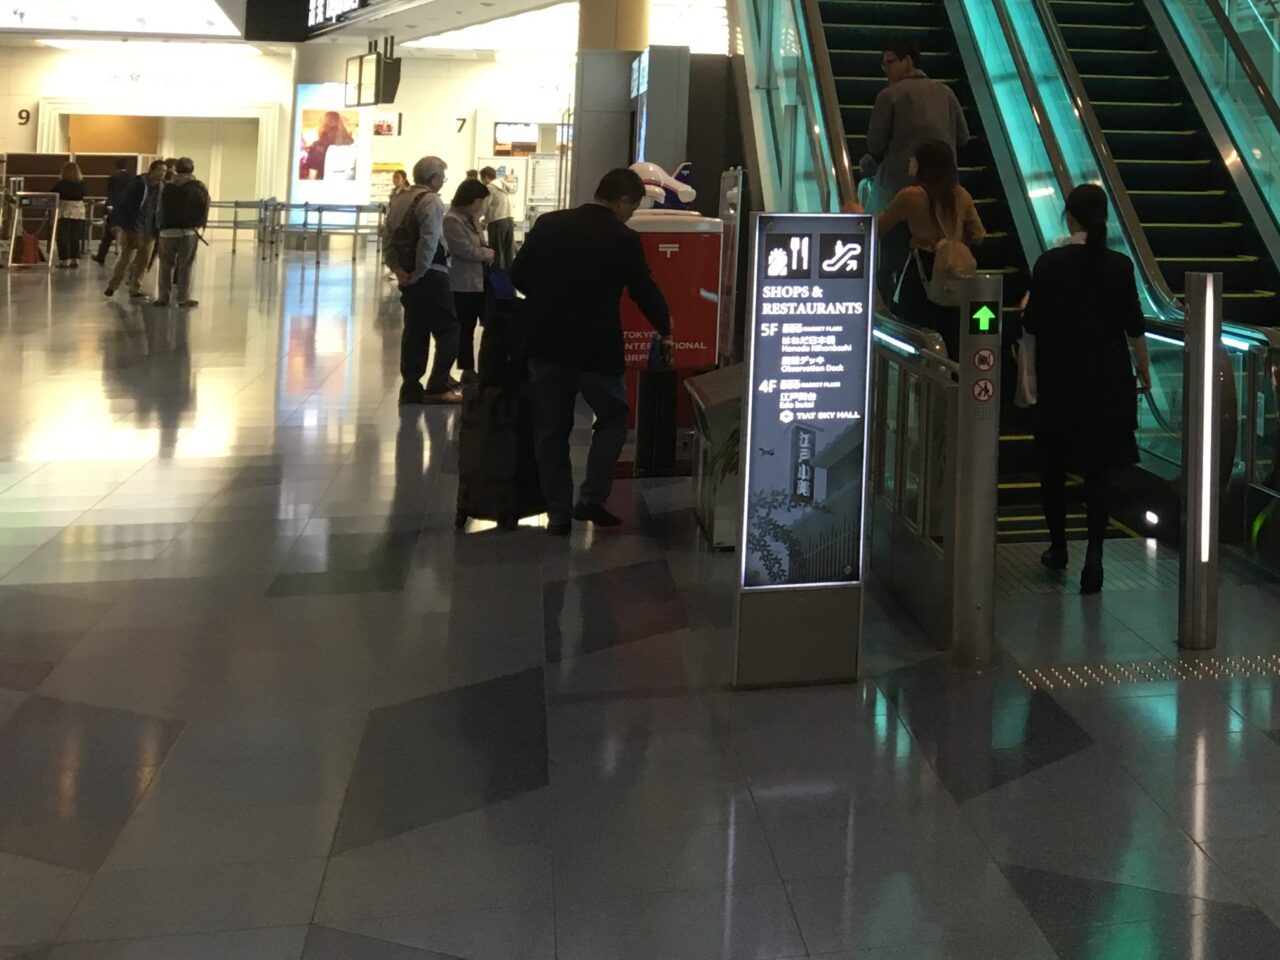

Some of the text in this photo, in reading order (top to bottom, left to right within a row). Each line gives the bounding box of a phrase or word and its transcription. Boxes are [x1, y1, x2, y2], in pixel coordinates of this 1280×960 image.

[18, 109, 31, 126] 9
[456, 118, 467, 133] 7
[762, 286, 823, 298] SHOPS &
[762, 302, 863, 315] RESTAURANTS
[760, 322, 778, 337] 5F
[780, 364, 844, 373] Observation Deck
[758, 379, 777, 394] 4F
[796, 410, 861, 420] TIAT SKY HALL
